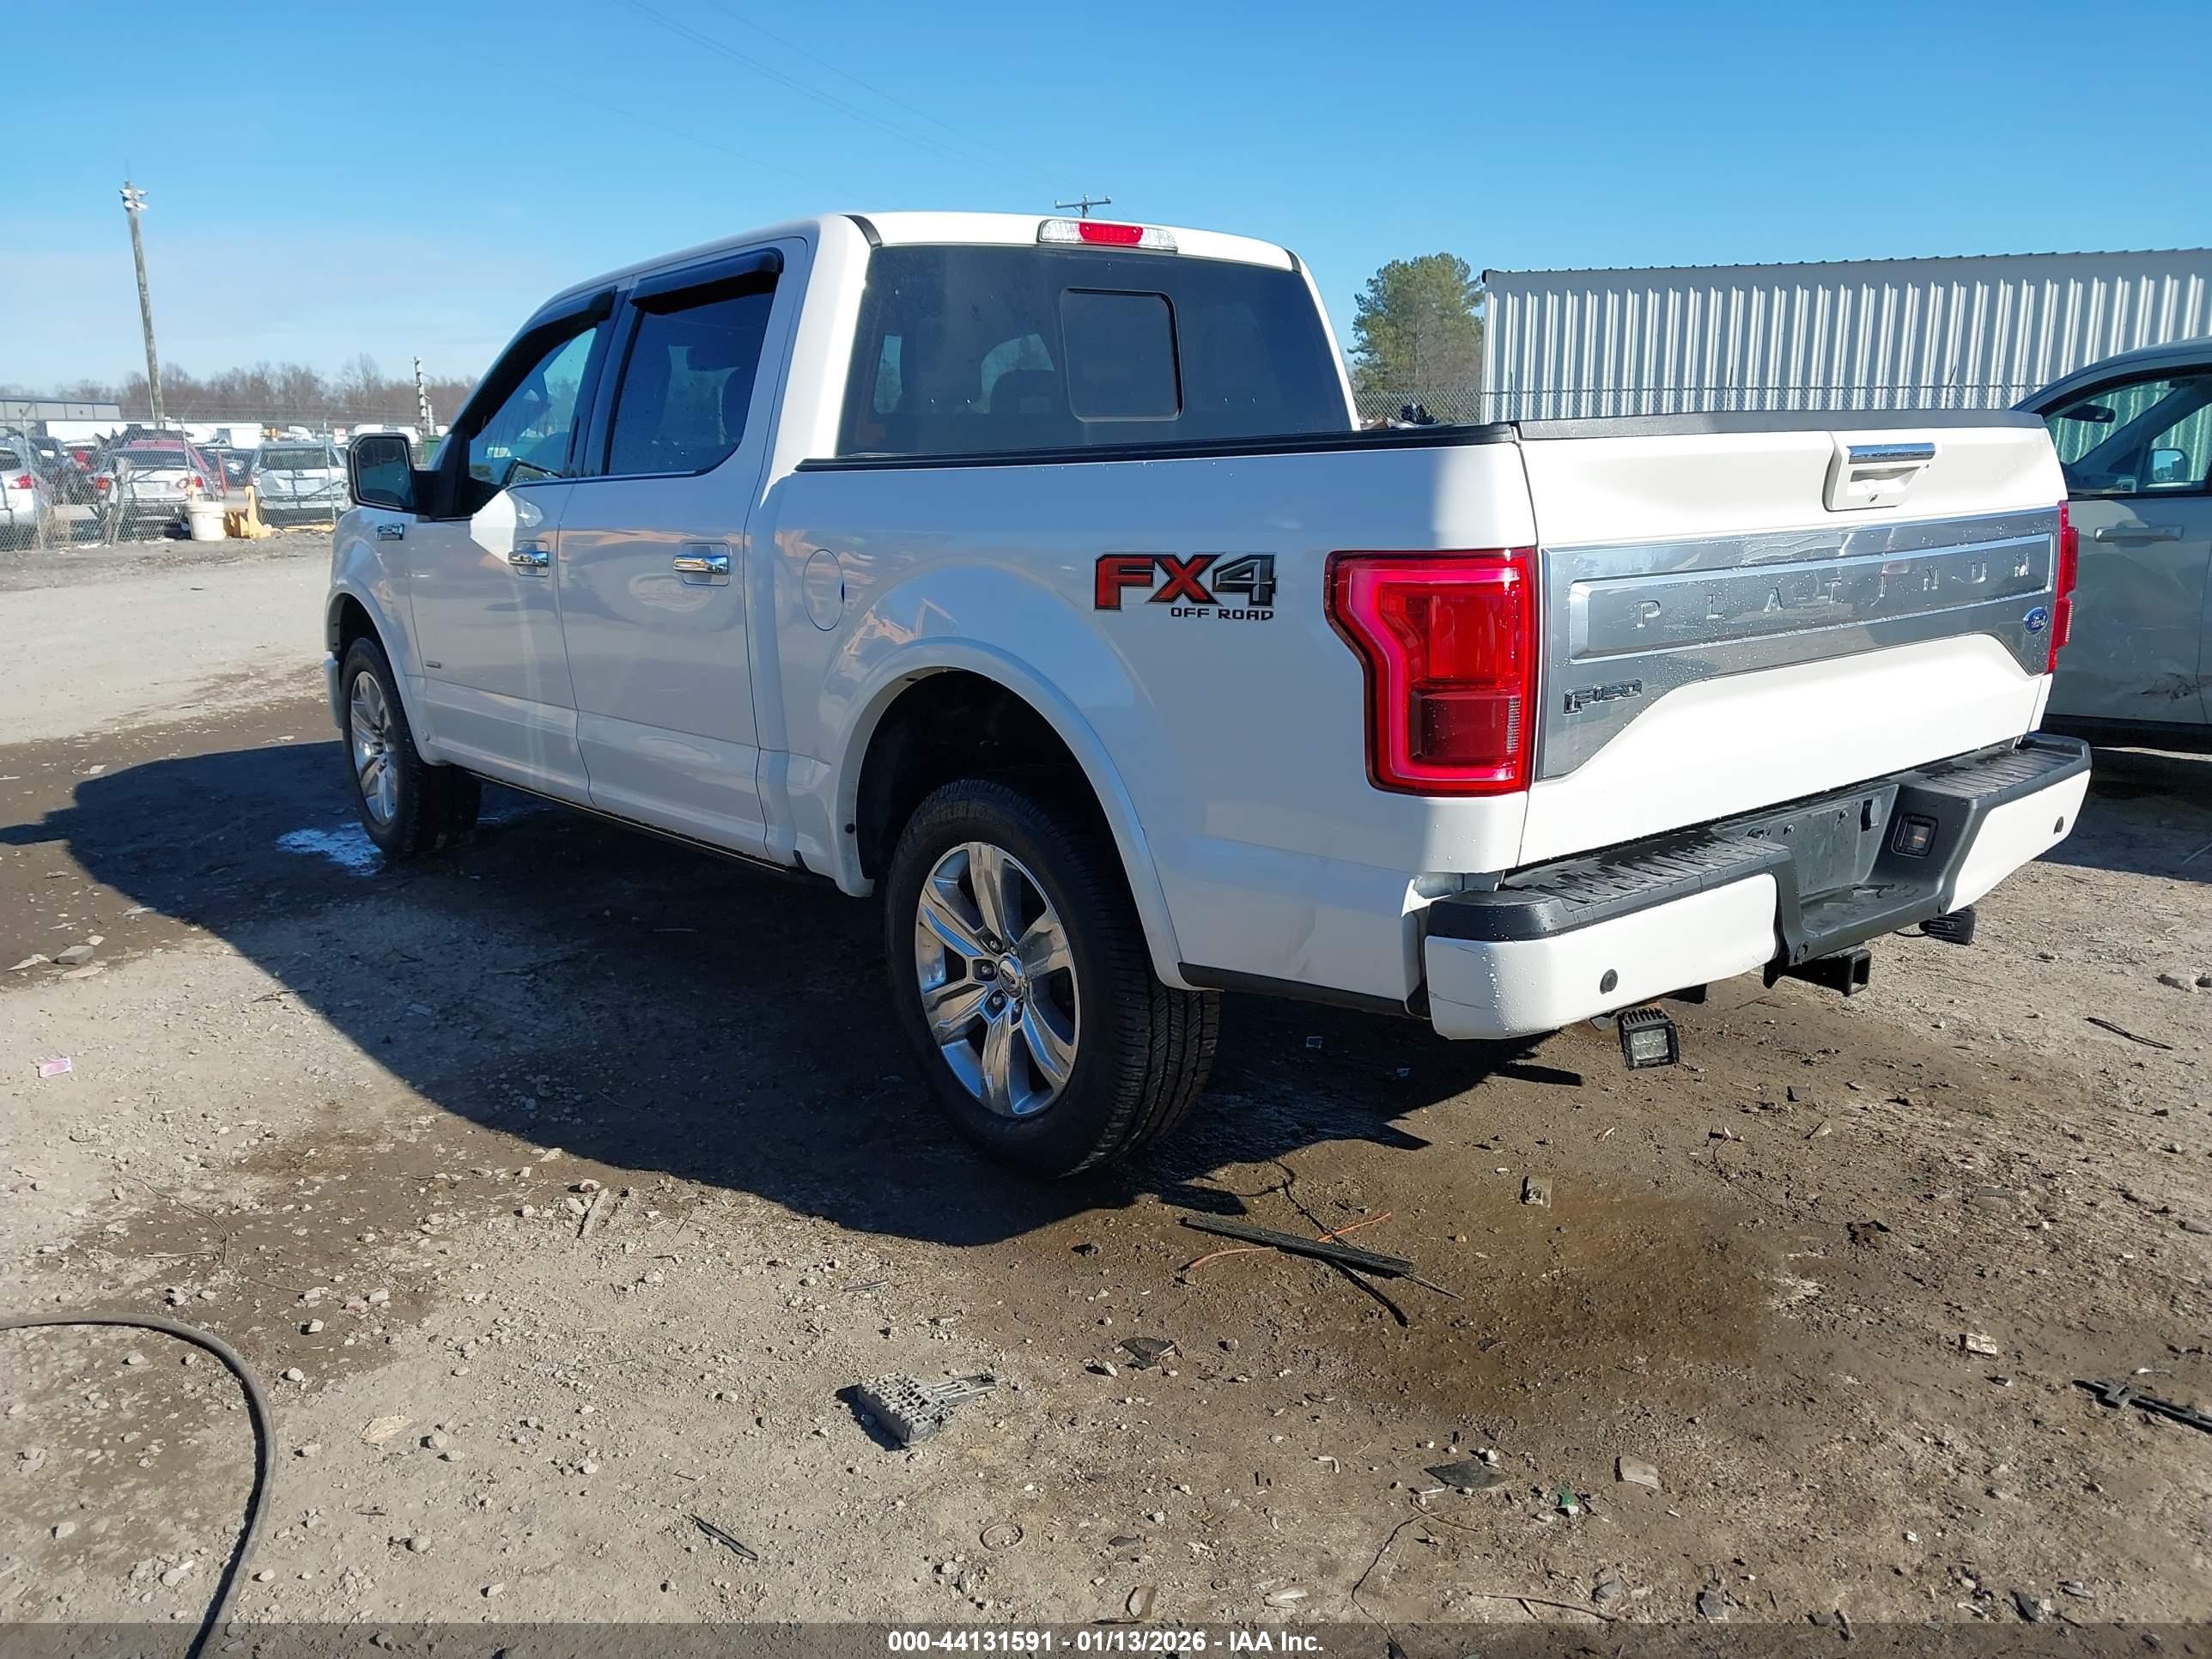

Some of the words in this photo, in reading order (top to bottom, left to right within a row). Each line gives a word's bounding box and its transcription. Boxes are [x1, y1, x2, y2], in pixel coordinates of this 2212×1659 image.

[1093, 551, 1277, 612] FX4
[1636, 554, 2030, 628] PLATINUM
[1170, 607, 1209, 619] OFF
[1218, 608, 1274, 621] ROAD
